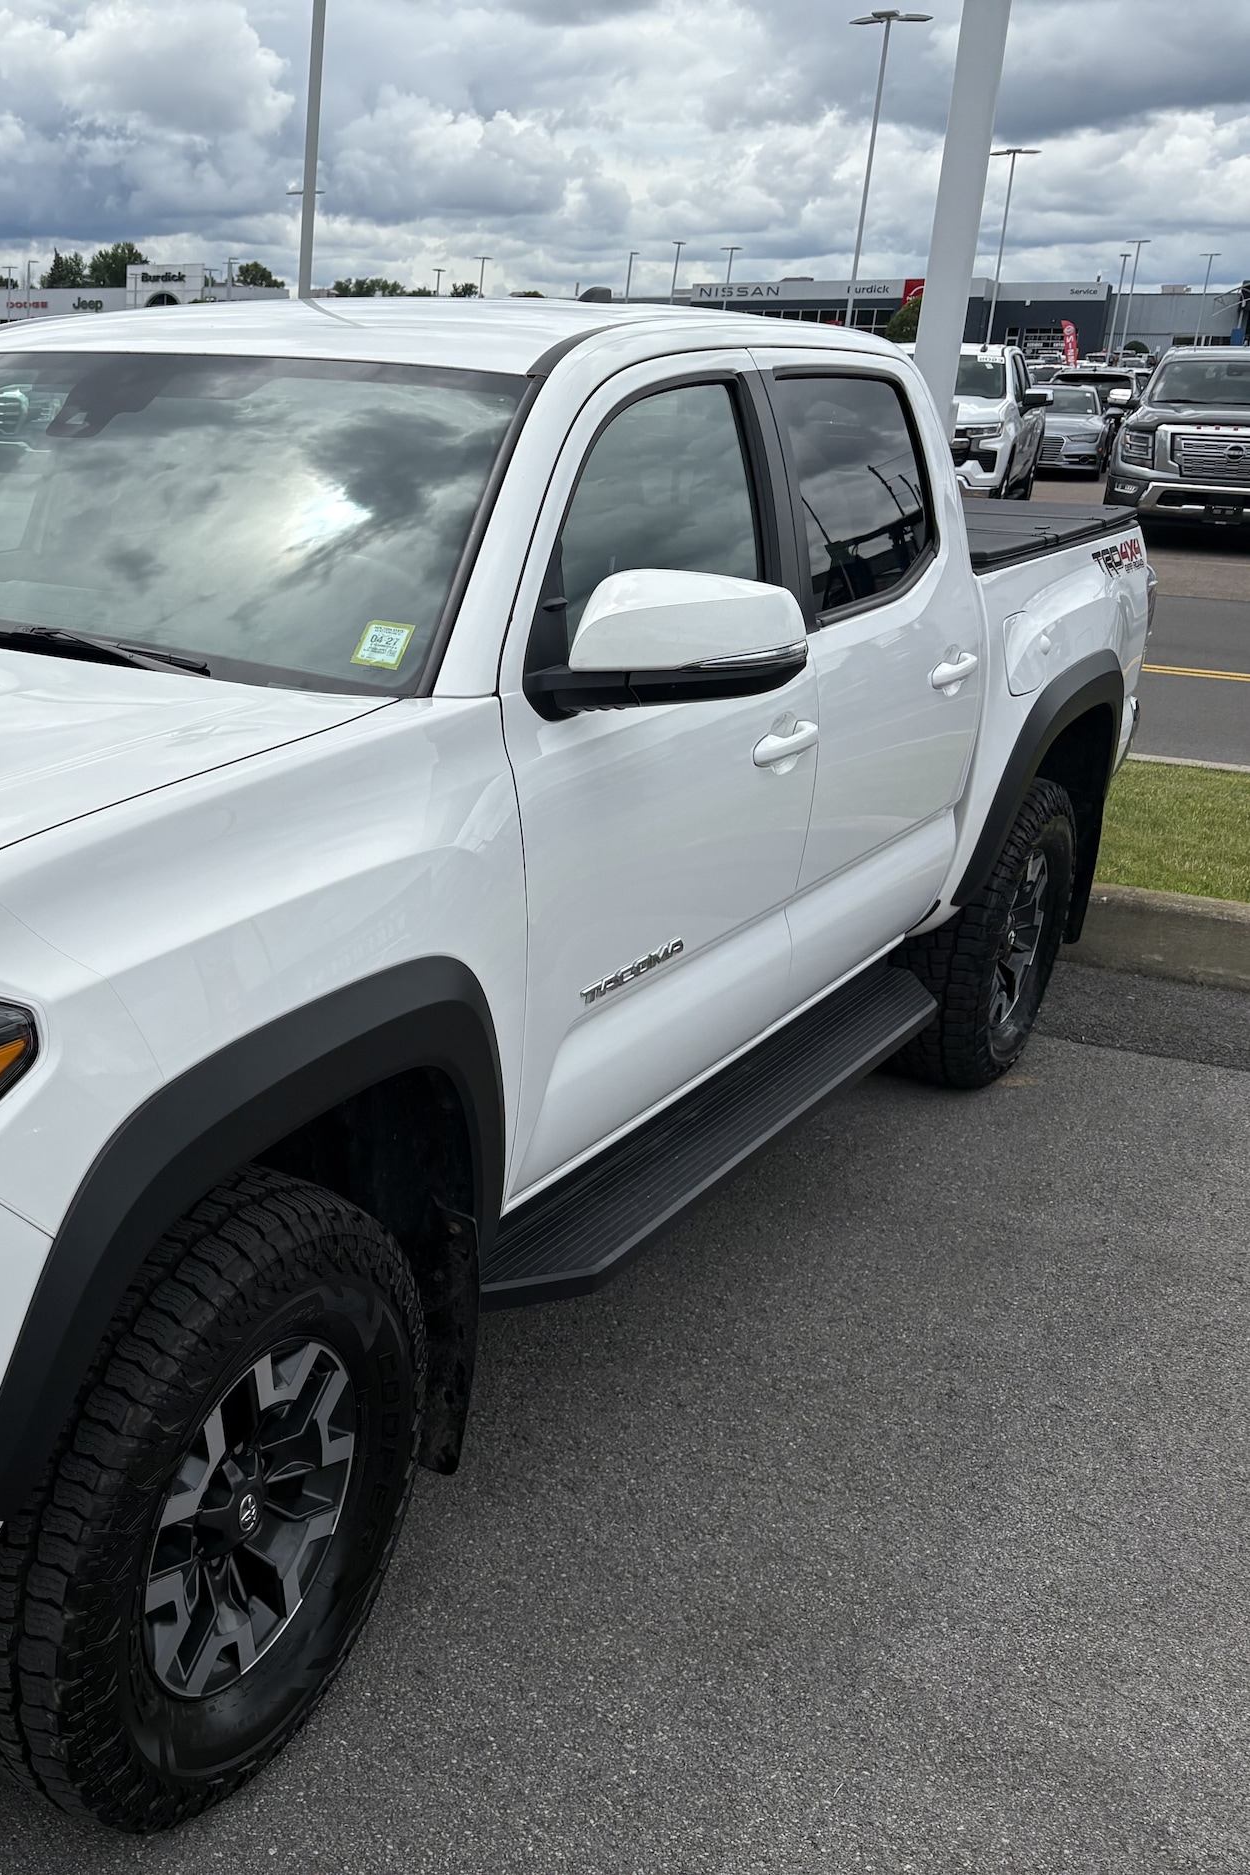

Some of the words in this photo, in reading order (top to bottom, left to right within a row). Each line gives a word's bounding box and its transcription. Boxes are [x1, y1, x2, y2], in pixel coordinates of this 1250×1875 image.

[141, 271, 186, 283] Burdick
[699, 286, 779, 298] NISSAN
[6, 301, 49, 309] DODGE
[72, 297, 103, 312] Jeep
[579, 936, 684, 1005] TACOMA
